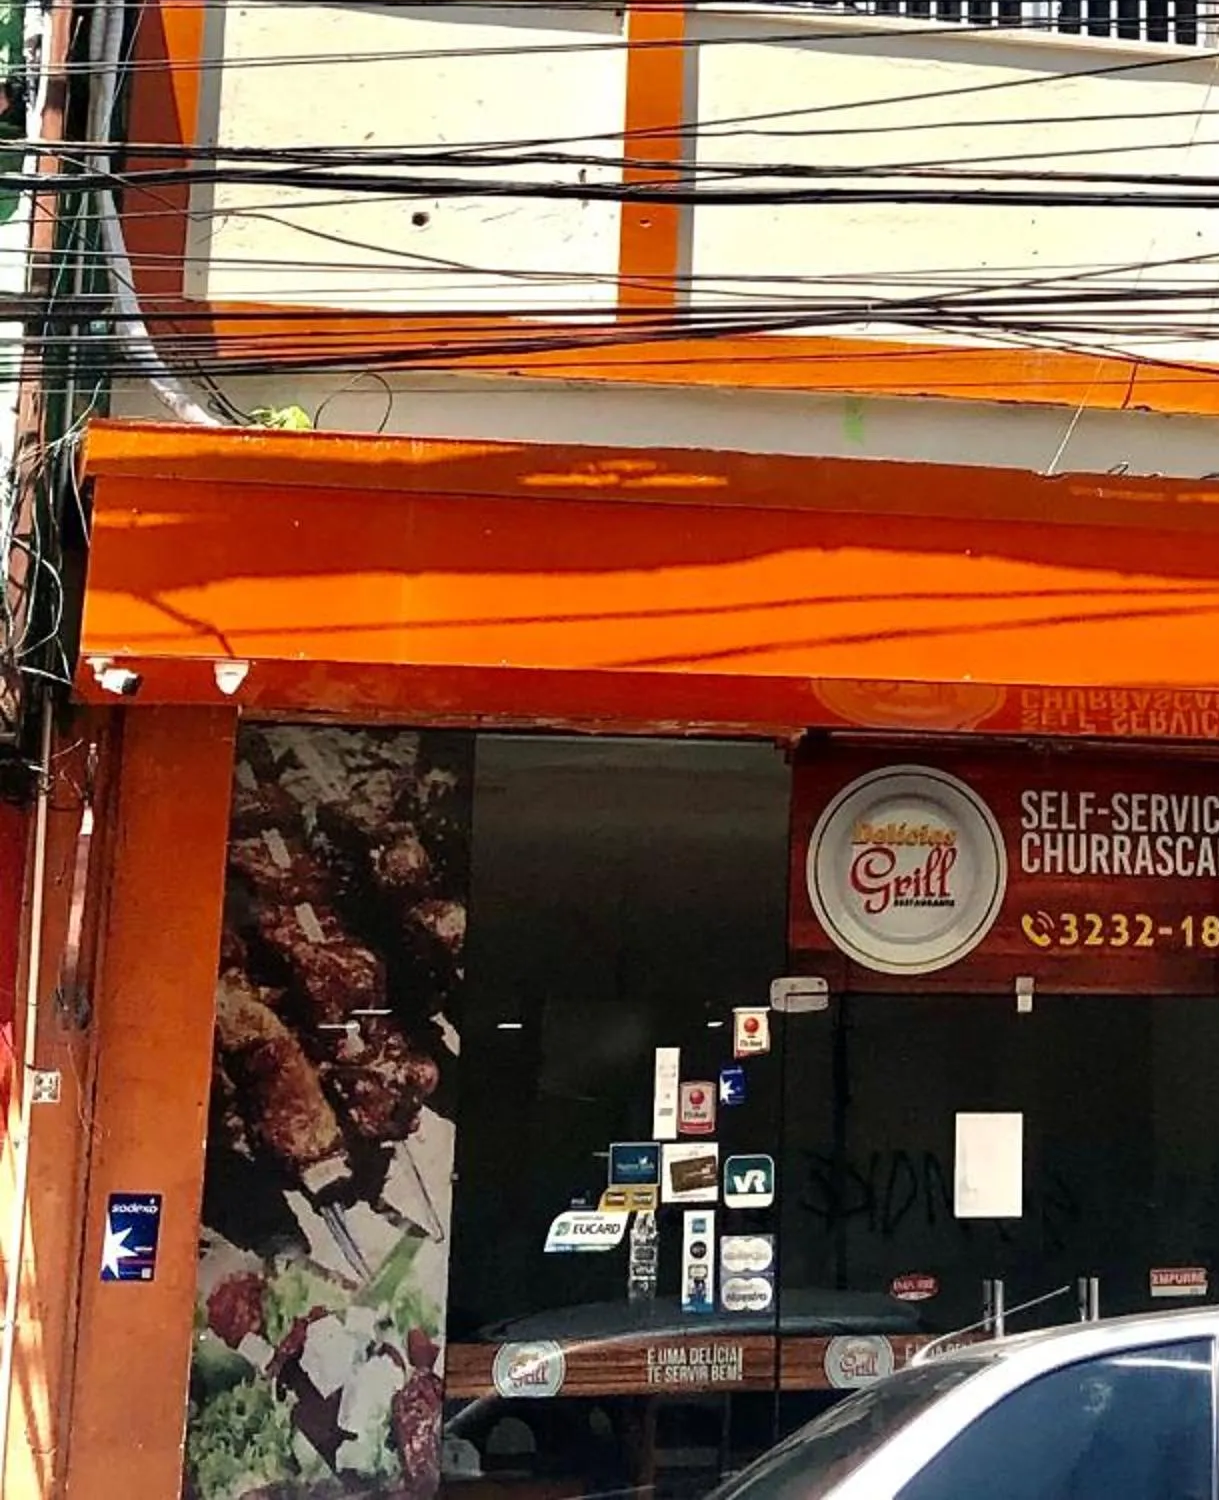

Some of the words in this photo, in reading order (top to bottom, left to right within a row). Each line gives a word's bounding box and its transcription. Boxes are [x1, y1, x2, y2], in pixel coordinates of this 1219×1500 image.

[851, 846, 958, 914] Grill
[658, 1347, 687, 1365] UMA
[647, 1366, 662, 1384] TE
[664, 1365, 709, 1383] SERVIR
